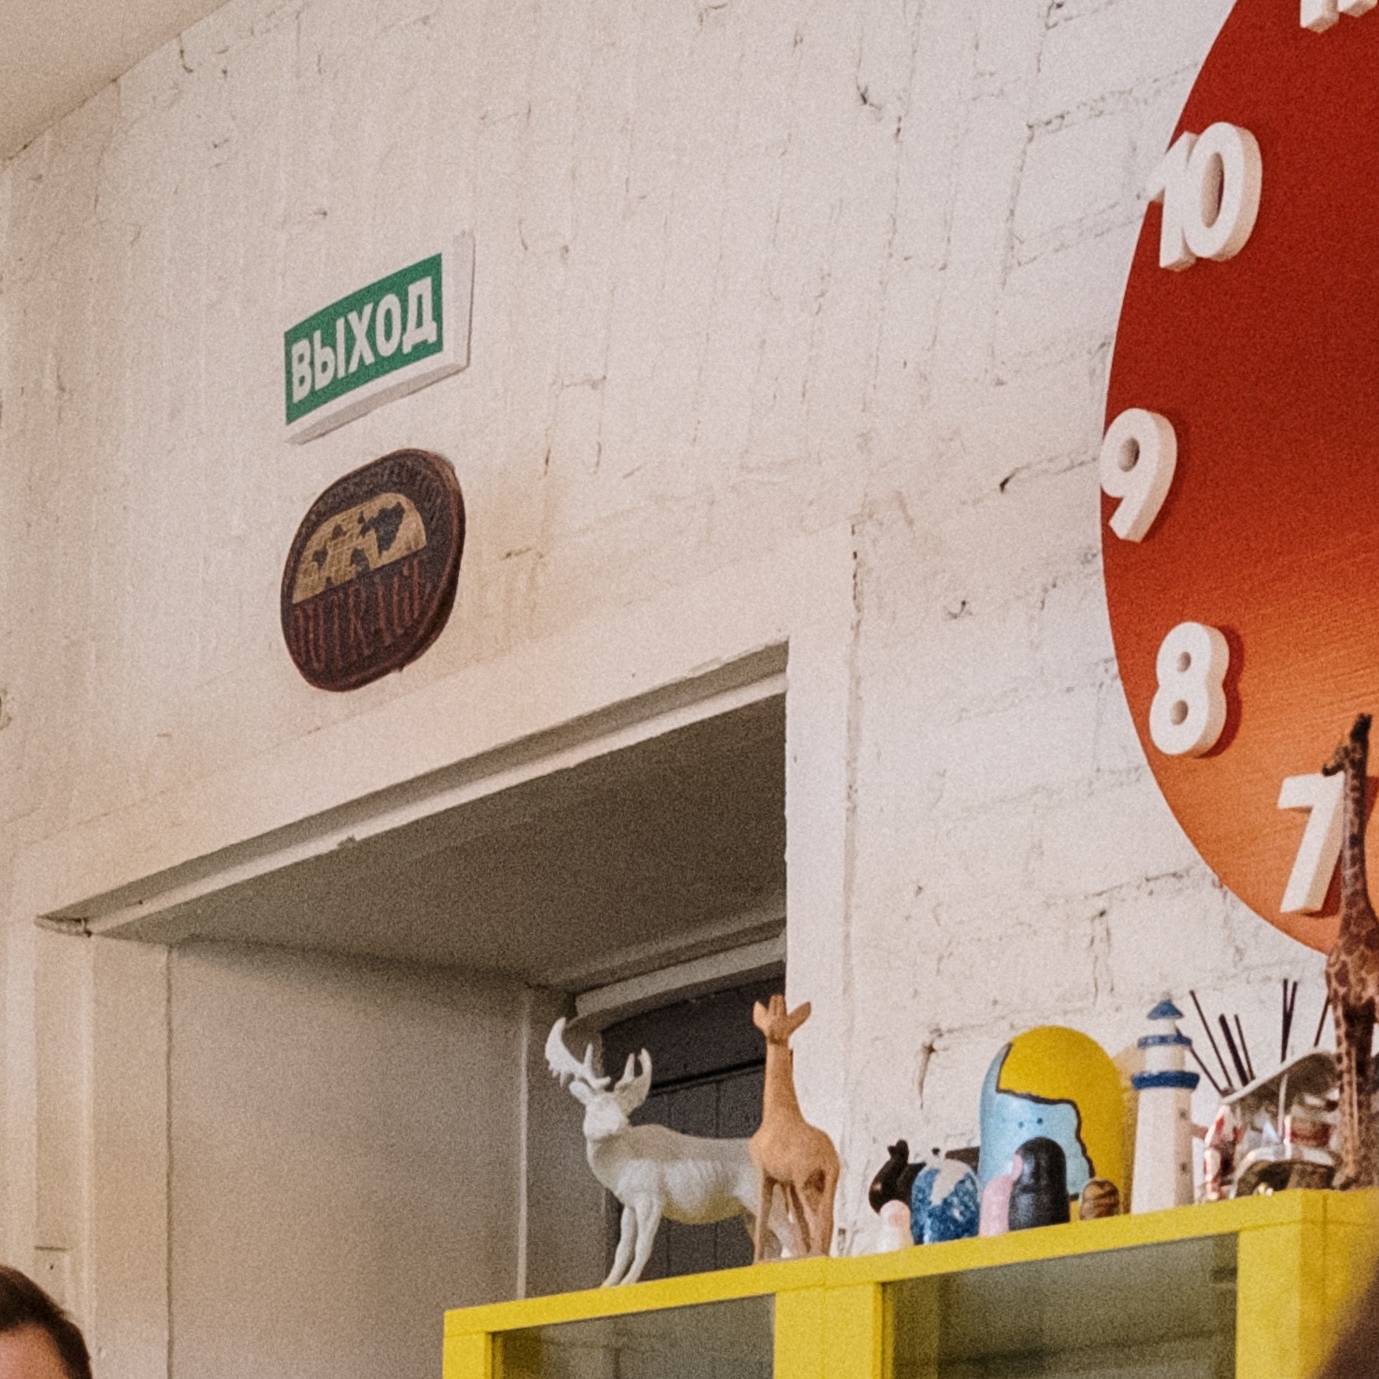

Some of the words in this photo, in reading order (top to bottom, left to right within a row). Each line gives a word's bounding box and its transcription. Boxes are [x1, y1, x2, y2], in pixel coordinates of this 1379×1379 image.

[1150, 120, 1263, 271] 10
[290, 275, 437, 404] ВЫХОД
[1100, 407, 1178, 543] 9
[1149, 621, 1230, 756] 8
[1277, 773, 1348, 913] 7
